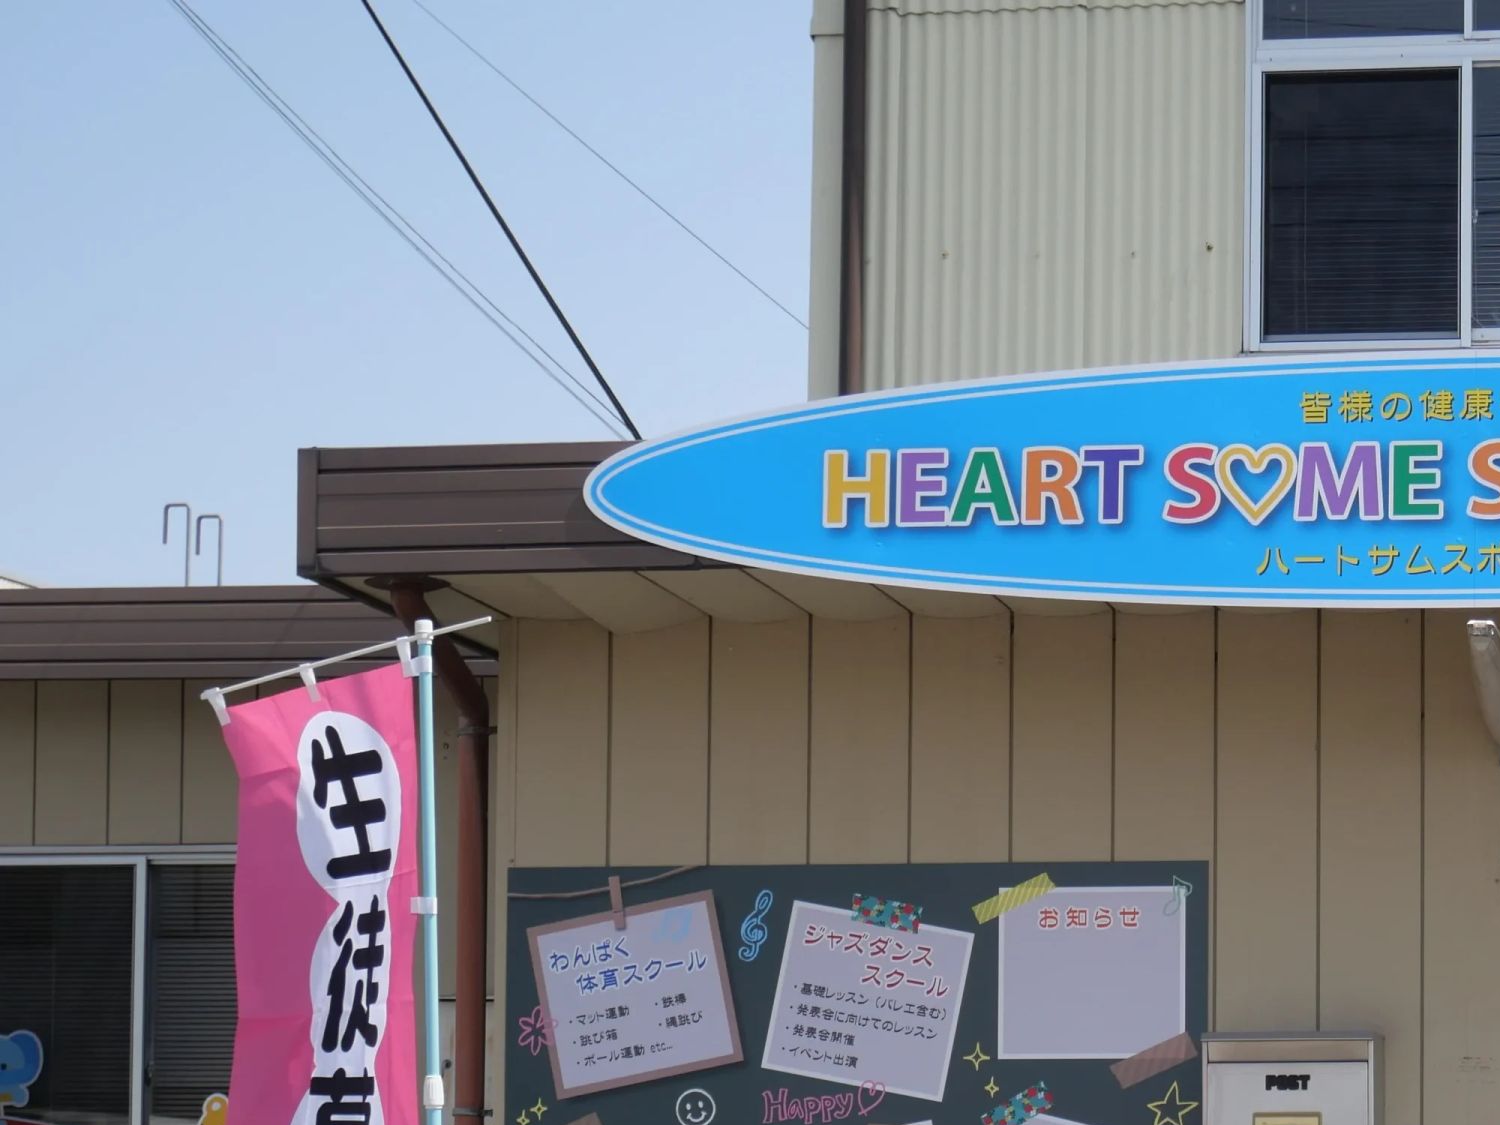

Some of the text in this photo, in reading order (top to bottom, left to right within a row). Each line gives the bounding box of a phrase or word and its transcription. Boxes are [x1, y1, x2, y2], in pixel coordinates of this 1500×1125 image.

[822, 444, 1145, 529] HEART
[1037, 906, 1141, 929] お知らせ
[549, 937, 630, 972] わんぱく
[804, 925, 933, 967] ジャズダンス
[576, 951, 707, 994] 体育スクール
[861, 965, 949, 997] スクール
[661, 993, 687, 1008] 鉄棒
[576, 1005, 630, 1025] マット運動
[797, 1003, 938, 1040] 発表会に向けてのレッスン
[580, 1029, 618, 1047] 跳び箱
[792, 1024, 856, 1046] 発表会開催
[584, 1044, 645, 1067] ボール運動
[789, 1047, 858, 1069] イベント出演
